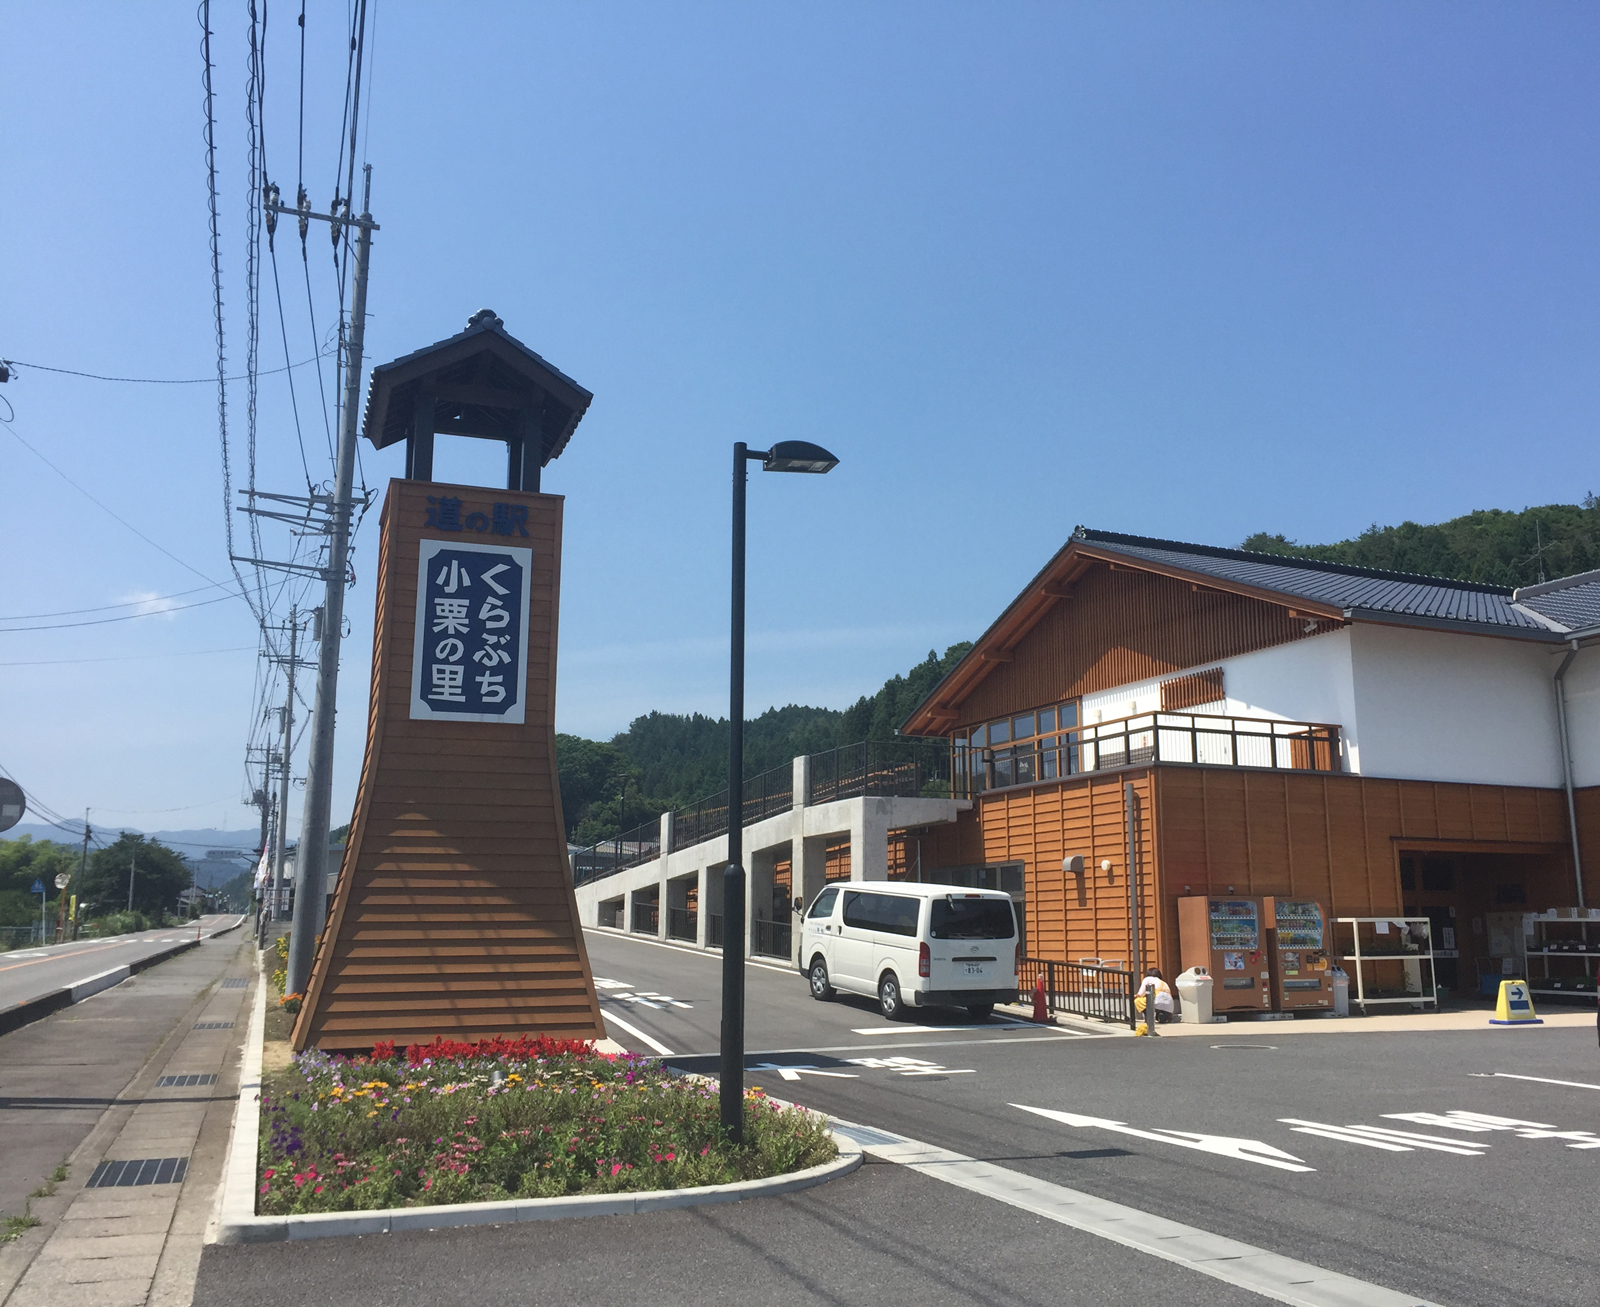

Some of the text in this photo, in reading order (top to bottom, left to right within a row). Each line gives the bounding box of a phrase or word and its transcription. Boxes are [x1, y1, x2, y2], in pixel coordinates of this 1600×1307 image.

[425, 497, 529, 537] 道の駅
[427, 559, 471, 703] 小栗の里
[473, 563, 512, 704] くらぶち
